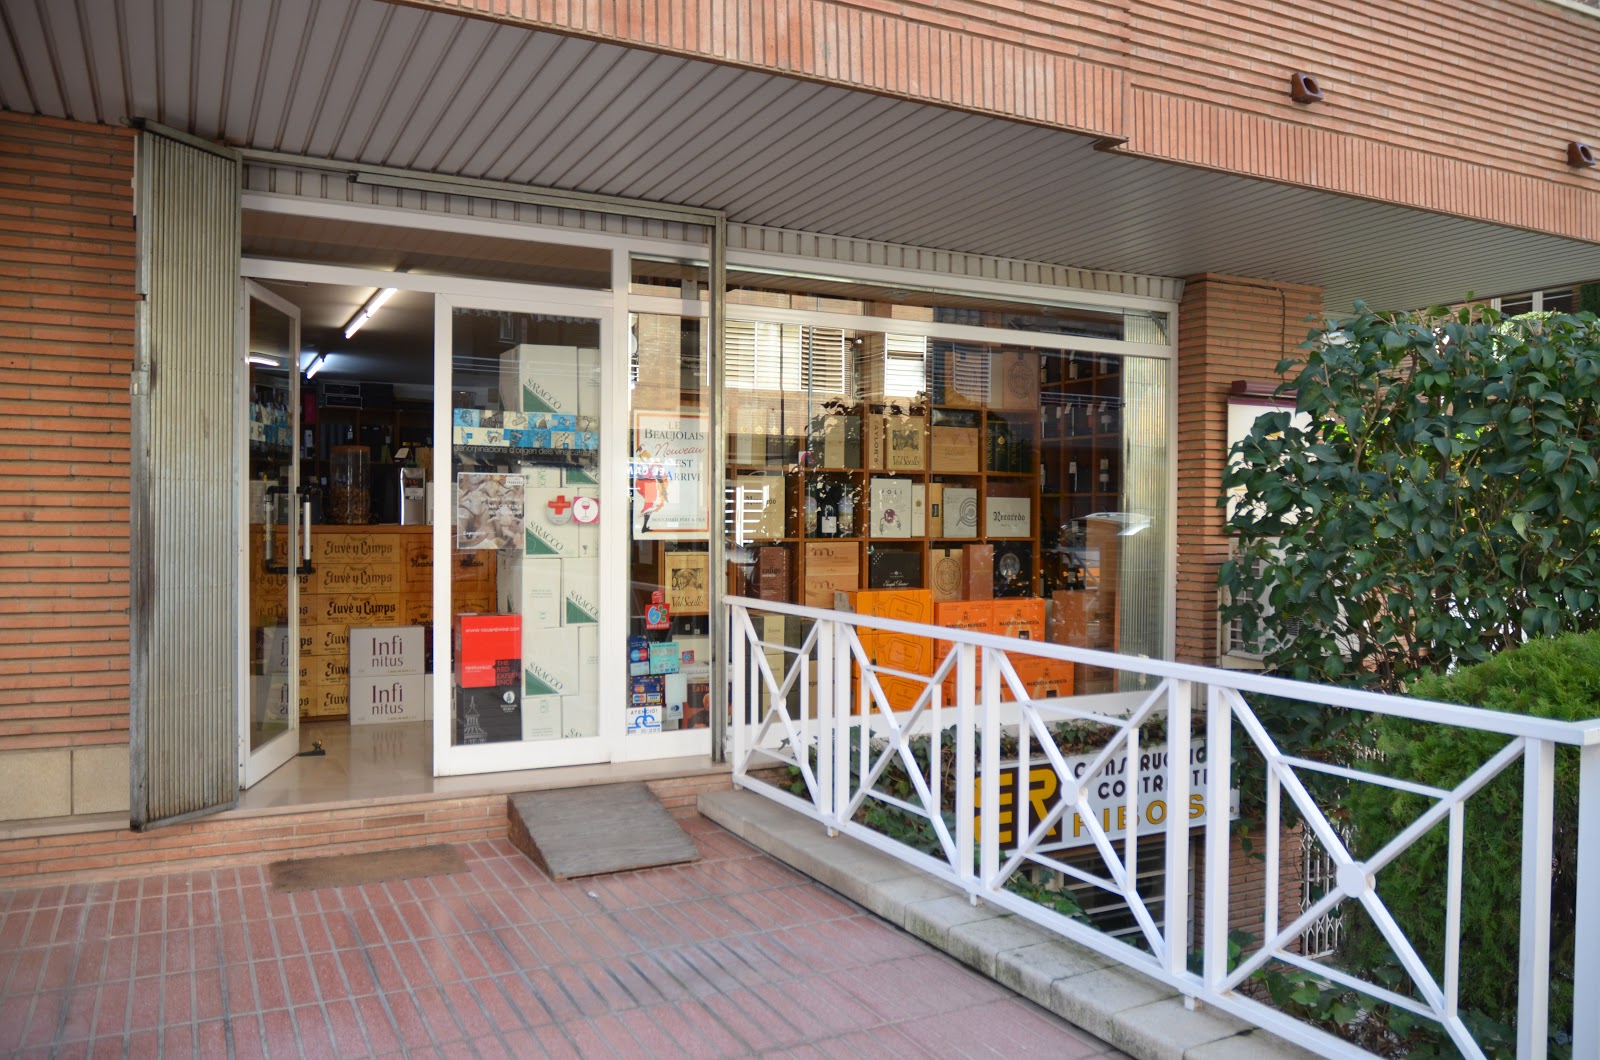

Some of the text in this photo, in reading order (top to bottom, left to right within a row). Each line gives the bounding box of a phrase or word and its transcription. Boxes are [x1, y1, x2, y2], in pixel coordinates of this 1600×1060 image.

[526, 378, 562, 410] SARACCO
[644, 429, 704, 442] BEAUJOLAIS
[654, 441, 705, 458] Nouveau
[675, 459, 694, 468] EST
[993, 512, 1026, 522] Recaredo
[529, 521, 564, 551] SARACCO
[360, 541, 393, 556] Camps
[360, 571, 392, 586] Camps
[364, 600, 396, 616] Camps
[324, 631, 349, 647] Juv
[372, 635, 403, 656] Infi
[325, 662, 349, 678] Juv
[371, 656, 404, 668] nitus
[529, 662, 564, 691] SARACCO
[323, 692, 349, 707] Juv
[372, 682, 403, 704] Infi
[371, 703, 404, 715] nitus
